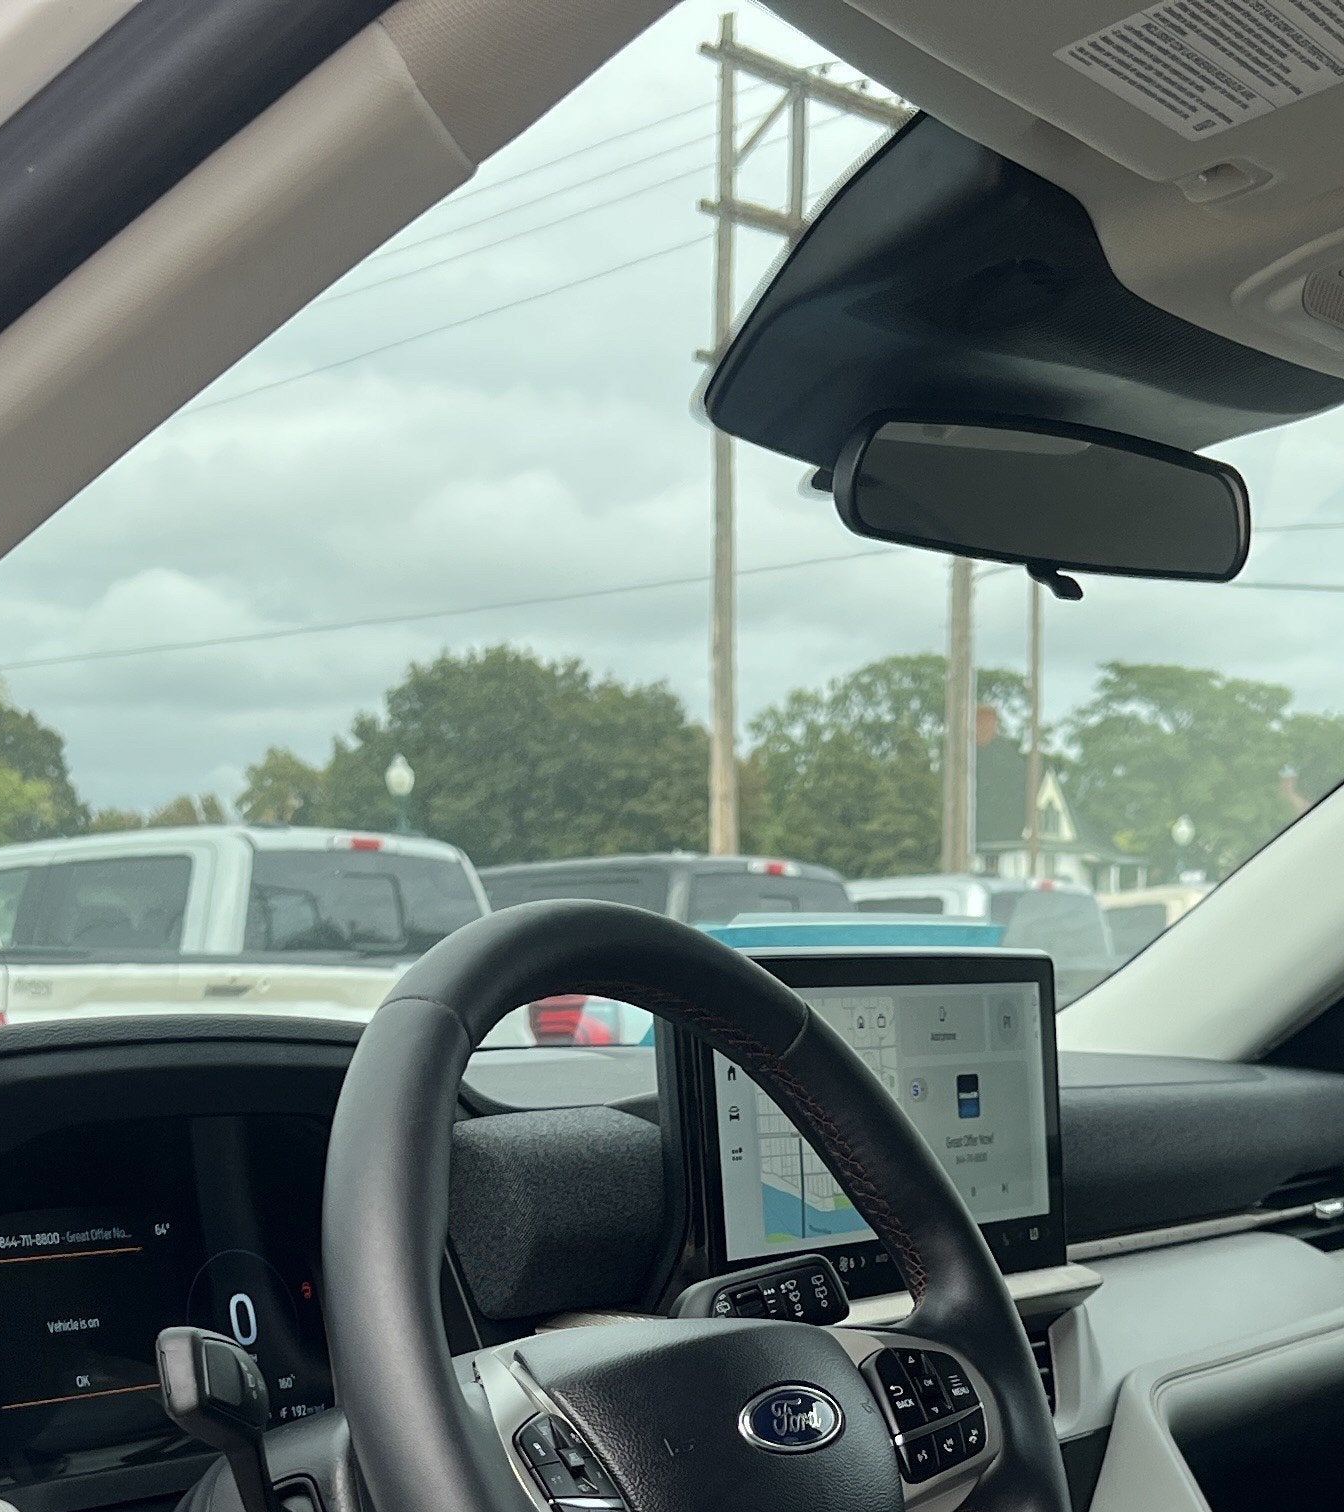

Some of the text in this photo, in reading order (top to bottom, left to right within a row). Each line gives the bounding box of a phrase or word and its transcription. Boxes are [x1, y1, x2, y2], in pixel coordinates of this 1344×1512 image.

[66, 1231, 90, 1243] Great
[47, 1318, 100, 1333] Vehicle is on
[229, 1293, 258, 1346] 0
[76, 1375, 91, 1388] OK
[895, 1398, 915, 1409] BACK
[771, 1397, 822, 1437] Ford
